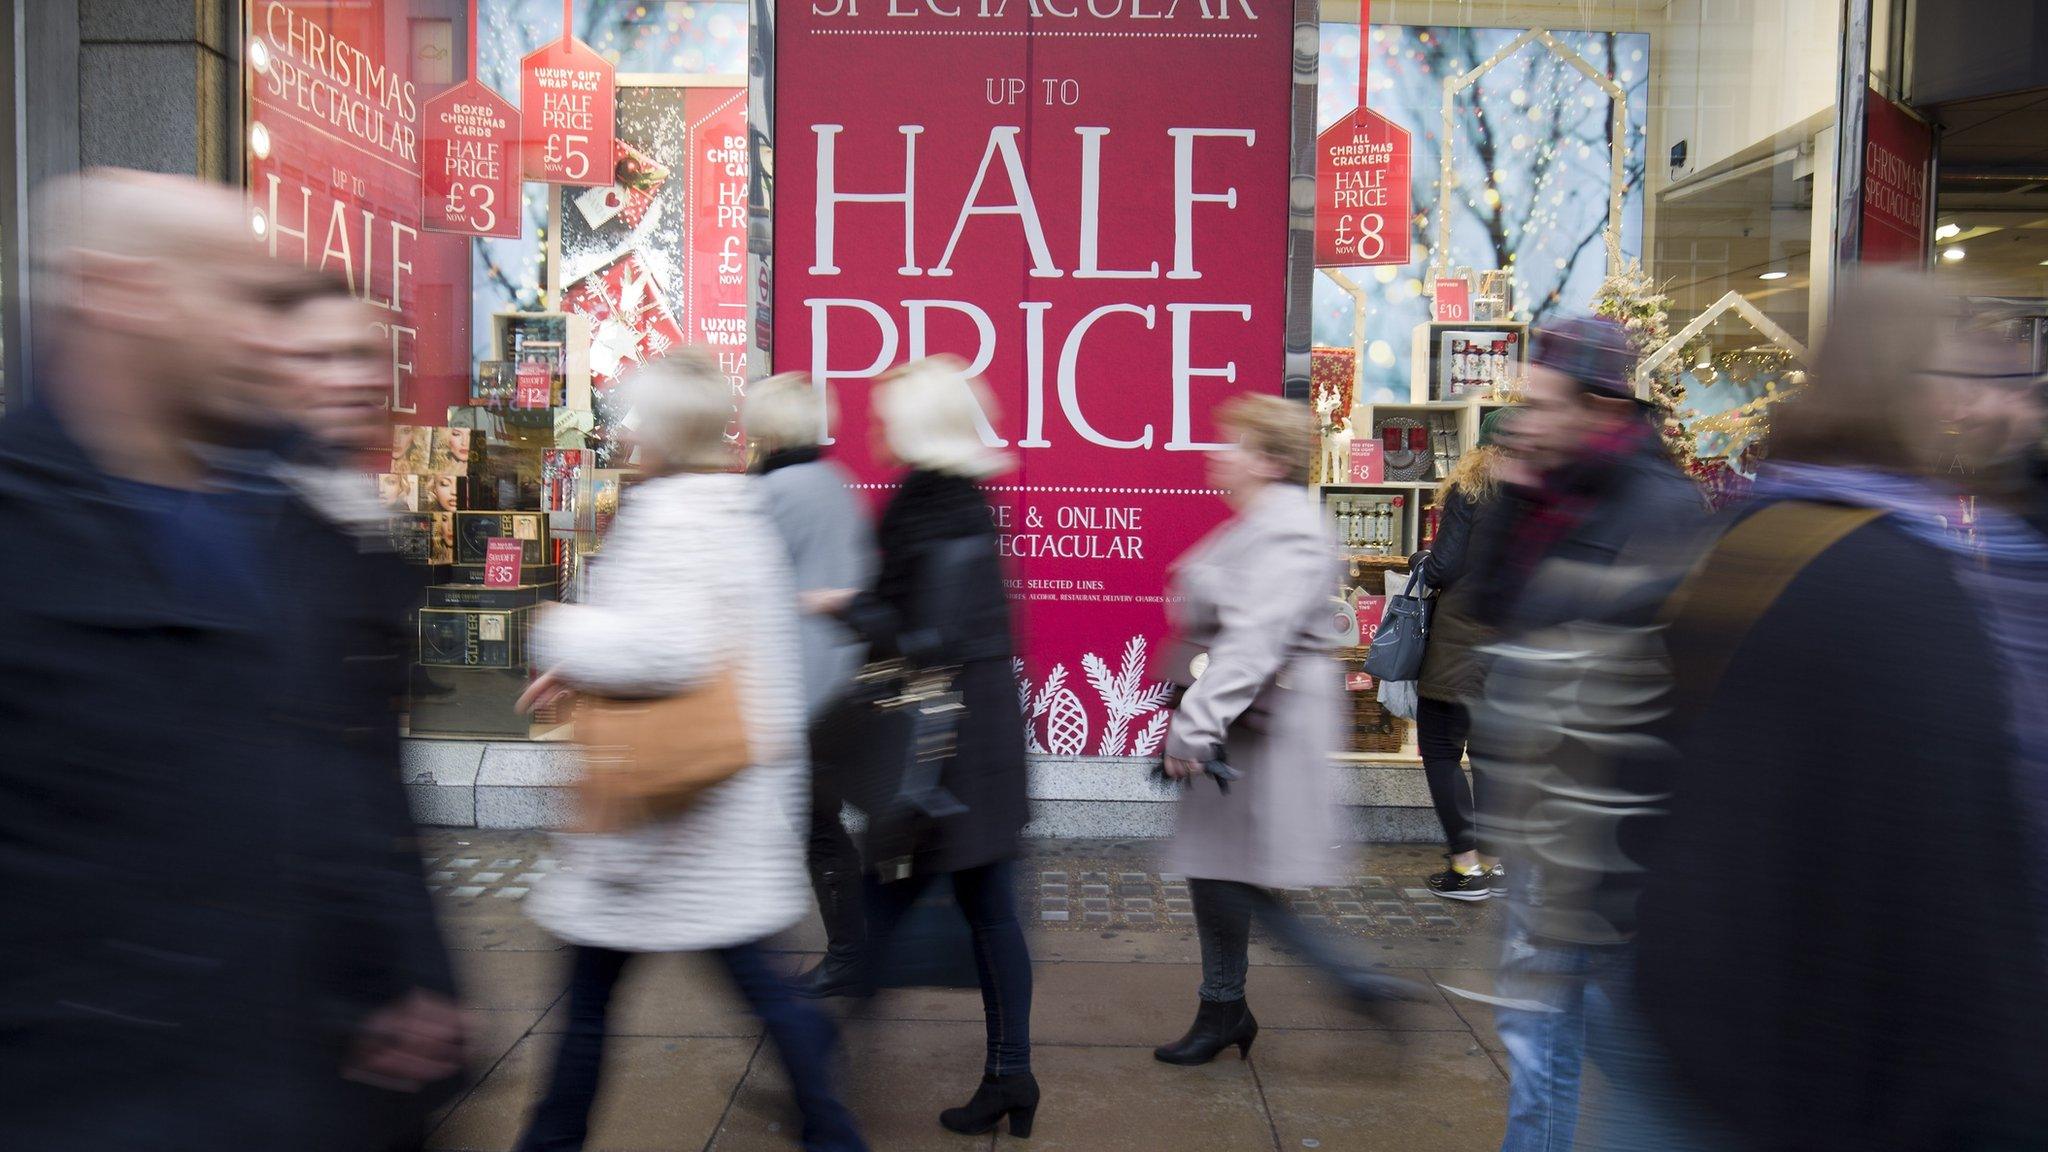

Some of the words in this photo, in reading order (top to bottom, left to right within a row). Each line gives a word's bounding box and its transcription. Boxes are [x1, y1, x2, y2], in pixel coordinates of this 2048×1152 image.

[267, 1, 416, 122] CHRISTMAS
[534, 67, 574, 80] LUXURY
[577, 70, 602, 81] GIFT
[538, 78, 567, 89] WRAP
[571, 81, 598, 92] PACK
[986, 77, 1026, 106] UP
[1042, 77, 1080, 106] TO
[267, 55, 417, 163] SPECTACULAR
[453, 103, 493, 117] BOXED
[543, 92, 592, 112] HALF
[440, 112, 506, 129] CHRISTMAS
[543, 111, 593, 130] PRICE
[454, 125, 492, 138] CARDS
[1353, 134, 1370, 144] ALL
[446, 138, 499, 161] HALF
[724, 136, 747, 149] BO
[1329, 142, 1393, 156] CHRISTMAS
[543, 133, 589, 179] £5
[1332, 154, 1390, 166] CRACKERS
[445, 157, 499, 180] PRICE
[544, 164, 563, 172] NOW
[1866, 141, 1923, 200] CHRISTMAS
[332, 167, 347, 190] UP
[351, 175, 366, 198] TO
[1335, 170, 1387, 190] HALF
[719, 182, 748, 205] HA
[808, 123, 1256, 279] HALF
[1334, 188, 1387, 208] PRICE
[1864, 176, 1921, 228] SPECTACULAR
[445, 181, 496, 232] £3
[446, 212, 466, 222] NOW
[717, 205, 747, 228] PR
[266, 172, 417, 312] HALF
[1335, 213, 1384, 259] £8
[1335, 246, 1356, 254] NOW
[719, 274, 743, 286] NOW
[1440, 303, 1462, 318] £10
[700, 317, 747, 332] LUXUR
[706, 331, 747, 346] WRAP
[803, 298, 1252, 451] PRICE
[1353, 465, 1369, 480] £8
[984, 505, 1011, 528] RE
[1026, 506, 1043, 528] &
[1057, 506, 1142, 530] ONLINE
[995, 534, 1144, 559] ECTACULAR
[488, 565, 513, 582] £35
[1027, 579, 1073, 589] SELECTED
[1077, 580, 1105, 590] LINES.
[1135, 595, 1163, 603] CHARGES
[1362, 623, 1378, 639] £8
